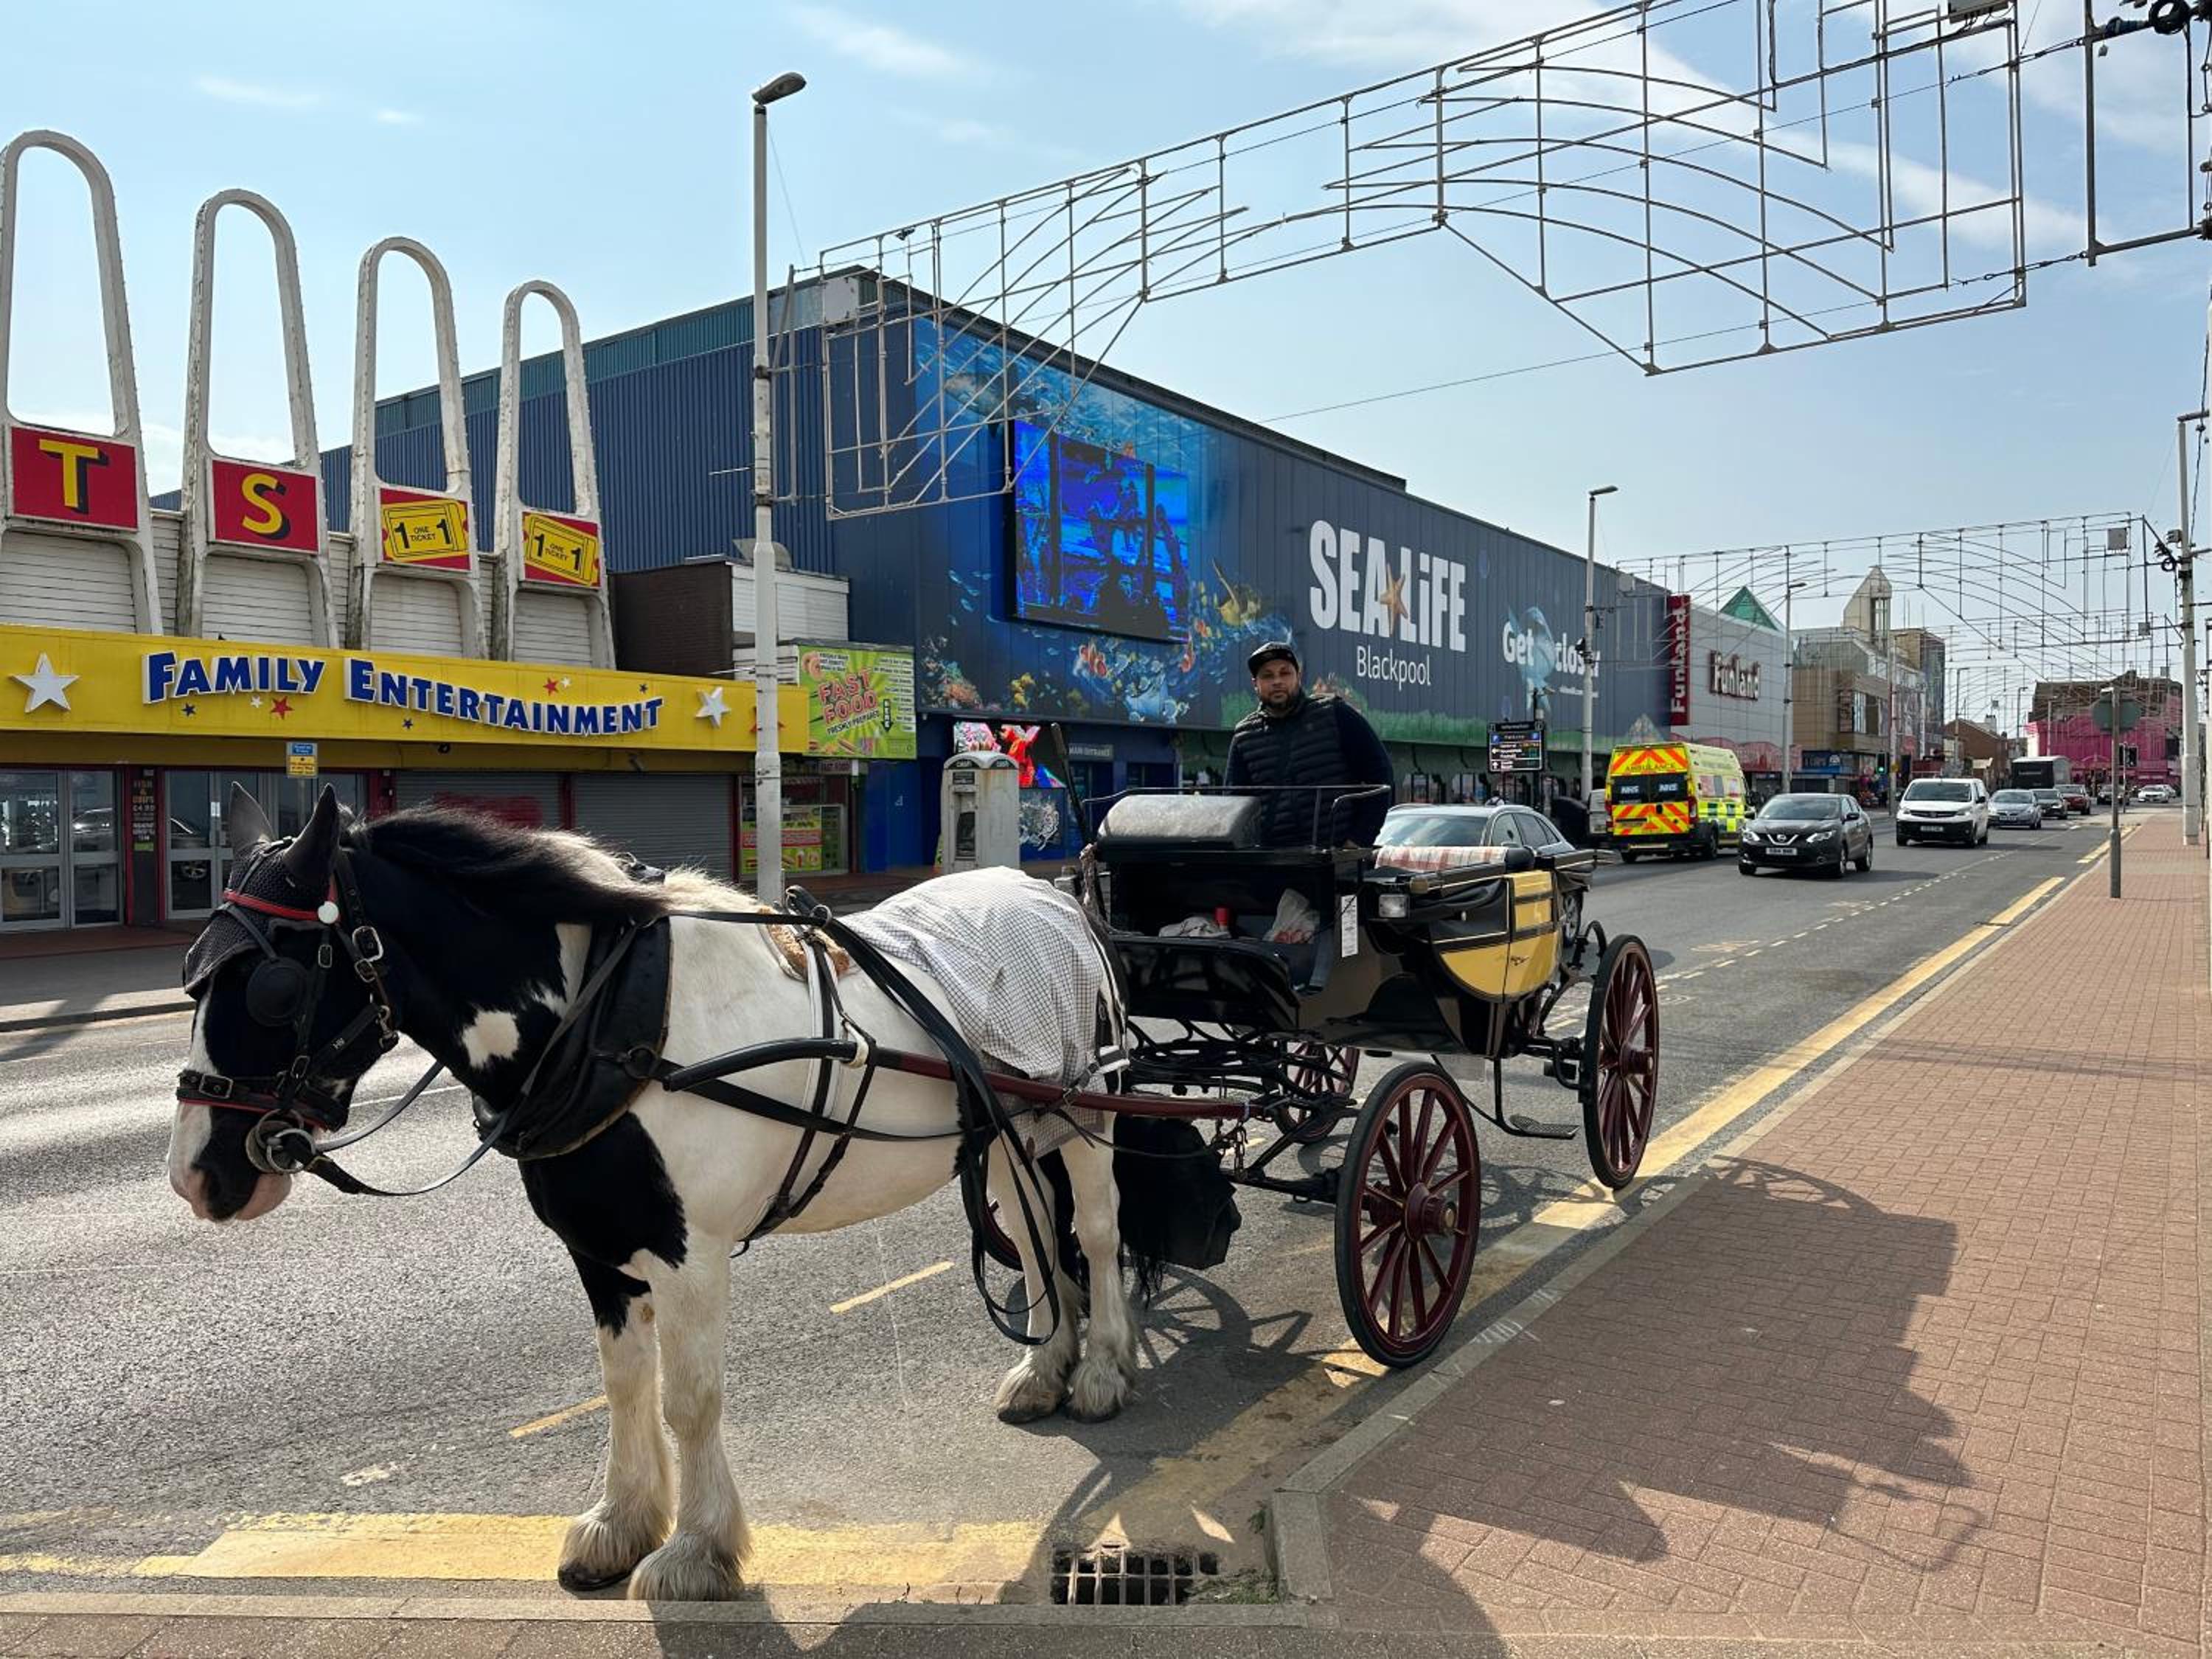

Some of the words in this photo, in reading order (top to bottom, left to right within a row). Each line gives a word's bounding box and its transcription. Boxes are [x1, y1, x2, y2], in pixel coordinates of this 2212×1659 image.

[39, 438, 108, 514] T
[241, 473, 290, 540] S
[394, 522, 410, 549] 1
[437, 518, 451, 545] 1
[535, 533, 545, 557] 1
[571, 547, 582, 571] 1
[1309, 520, 1391, 639] SEA
[1503, 621, 1534, 667] Get
[1356, 644, 1432, 692] Blackpool
[1671, 608, 1687, 713] Funland
[1713, 650, 1761, 700] Funland
[818, 667, 871, 704] FAST
[824, 689, 877, 723] FOOD
[827, 720, 851, 734] FRESHLY
[1069, 746, 1083, 755] MAIN
[1626, 762, 1675, 772] AMBULANCE
[1621, 785, 1639, 794] NHS
[1659, 783, 1679, 793] NHS
